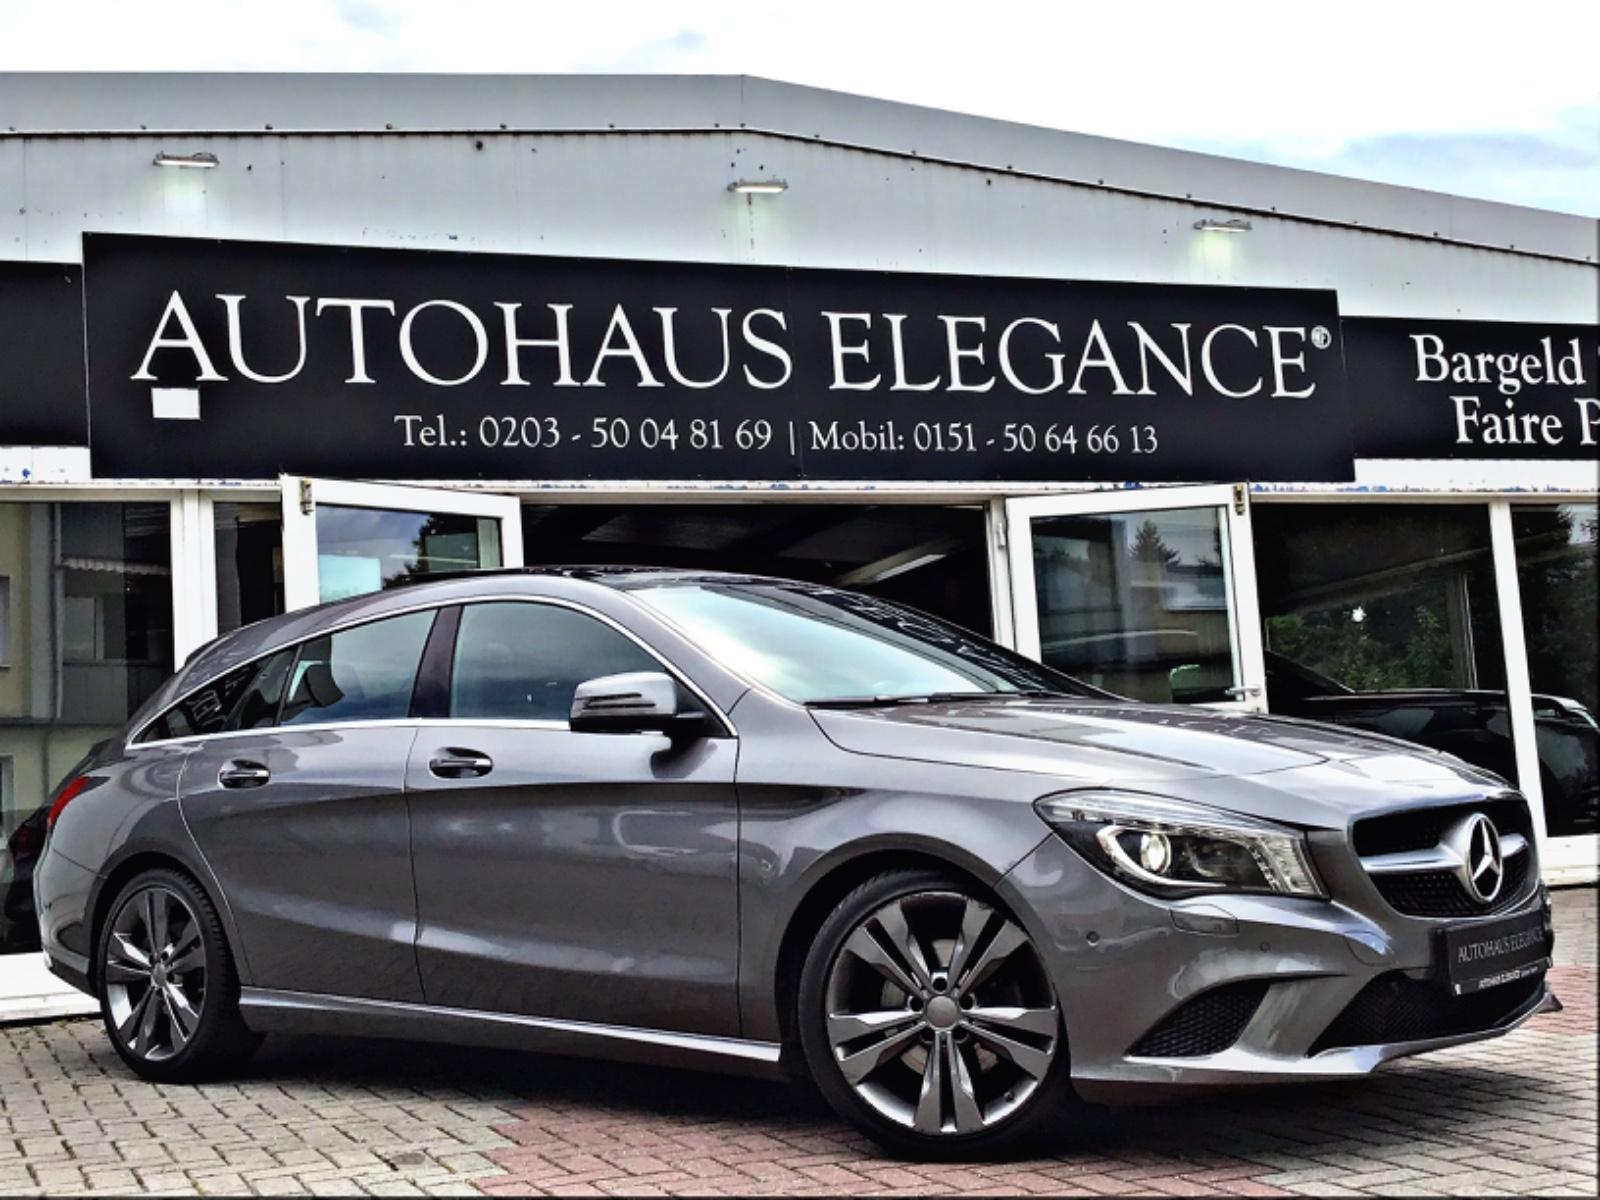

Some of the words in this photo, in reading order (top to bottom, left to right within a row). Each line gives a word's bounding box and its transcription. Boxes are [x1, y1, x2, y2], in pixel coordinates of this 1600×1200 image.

[130, 289, 793, 390] AUTOHAUS
[1409, 334, 1587, 395] Bargeld
[393, 413, 467, 447] Tel.:
[479, 415, 560, 448] 0203
[591, 417, 630, 448] 50
[640, 418, 679, 451] 04
[689, 418, 723, 450] 81
[735, 419, 772, 450] 69
[808, 420, 905, 451] Mobil:
[913, 422, 977, 452] 0151
[1003, 423, 1036, 452] 50
[1044, 423, 1078, 454] 64
[1086, 424, 1120, 453] 66
[1130, 425, 1158, 454] 13
[1449, 395, 1564, 445] Faire
[1458, 936, 1510, 963] AUTOHAUS
